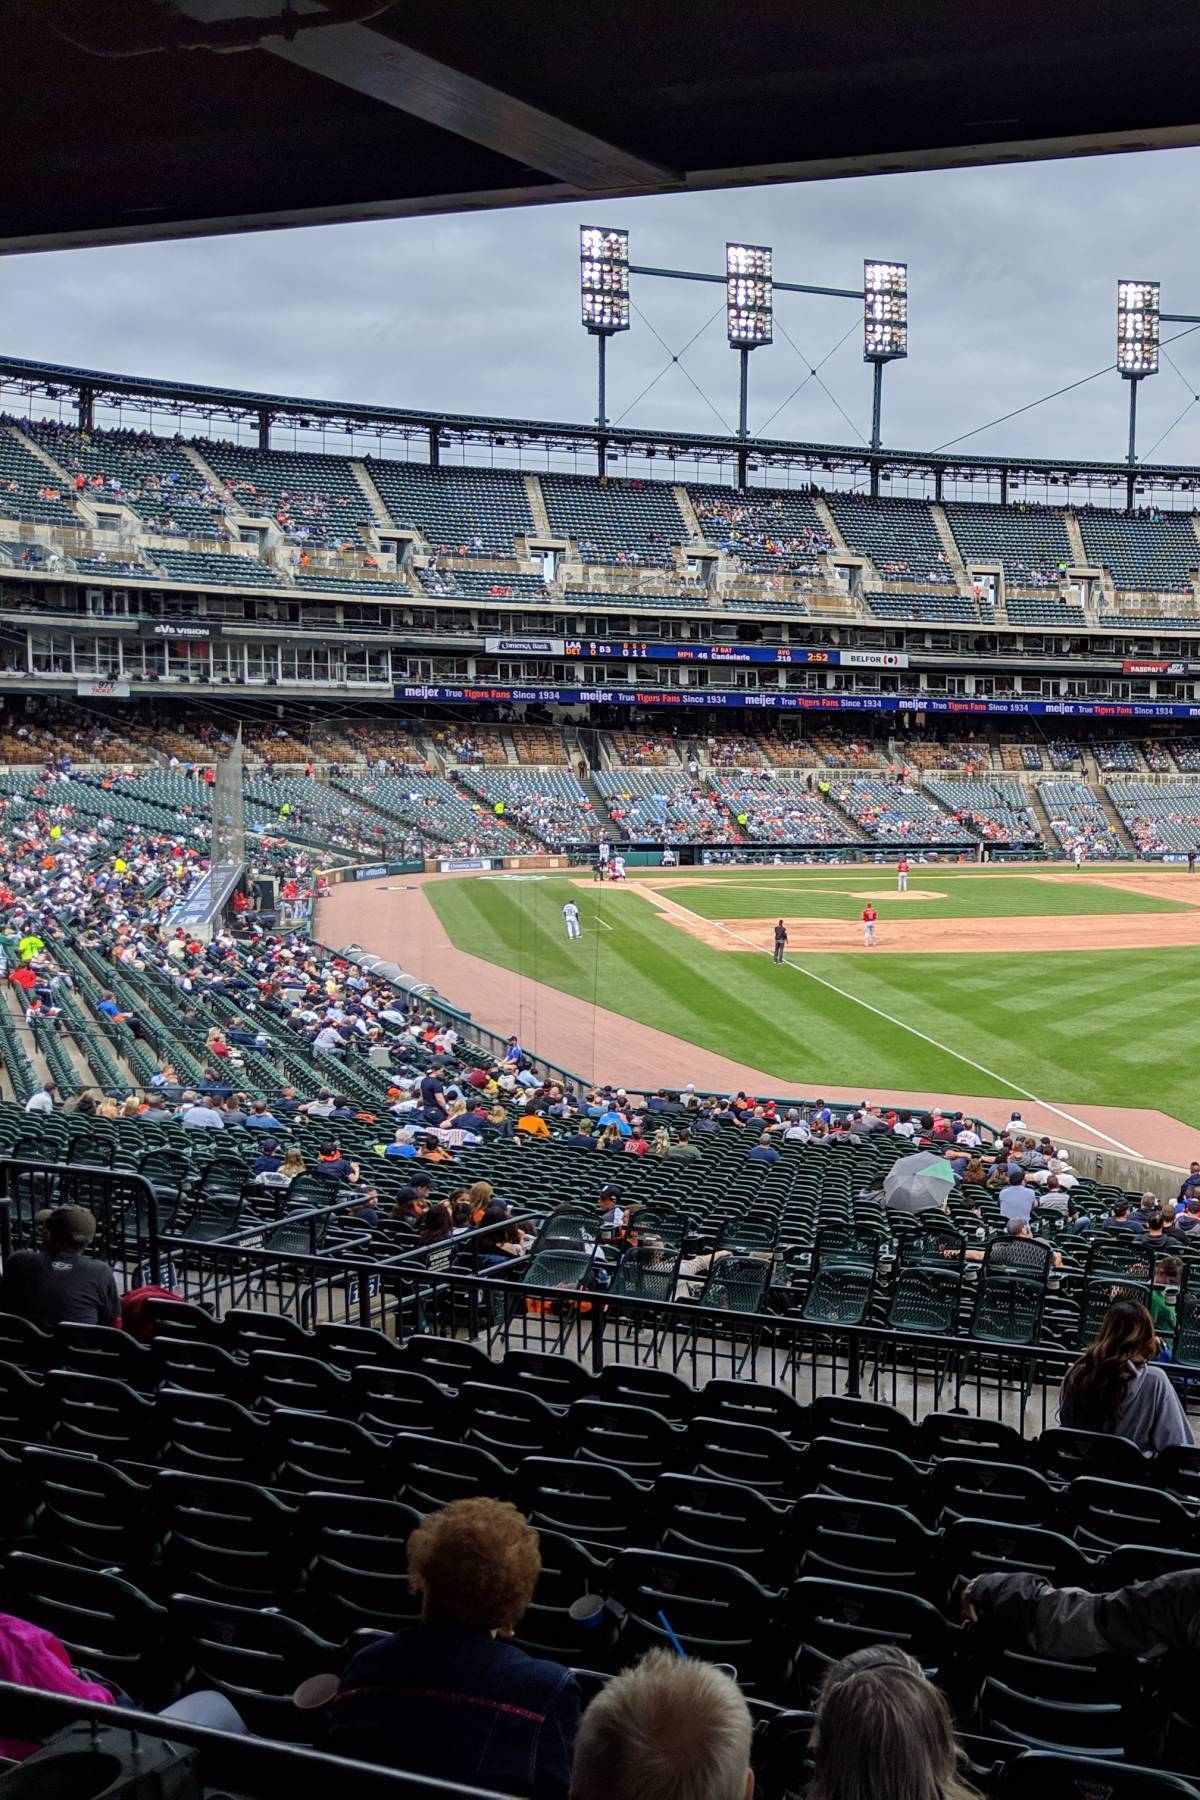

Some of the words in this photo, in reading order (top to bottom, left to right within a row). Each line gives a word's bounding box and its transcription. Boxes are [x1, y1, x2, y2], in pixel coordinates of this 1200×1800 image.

[565, 641, 582, 649] LAA
[711, 653, 750, 661] Candelario
[807, 653, 829, 662] 2:52
[850, 655, 881, 663] BELFOR
[405, 686, 439, 699] meijer
[445, 689, 462, 697] True
[464, 689, 489, 699] Tigers
[491, 689, 511, 699] Fans
[513, 690, 535, 699] Since
[538, 691, 560, 699] 1934
[580, 690, 612, 703] meijer
[618, 693, 635, 701] True
[636, 693, 660, 704] Tigers
[662, 694, 680, 703] Fans
[682, 695, 704, 703] Since
[706, 695, 727, 704] 1934
[745, 695, 776, 707] meijer
[781, 698, 796, 706] True
[797, 698, 820, 708] Tigers
[821, 698, 838, 707] Fans
[840, 699, 861, 707] Since
[863, 700, 881, 708] 1934
[899, 699, 927, 711] meijer
[948, 702, 969, 712] Tigers
[970, 703, 987, 711] Fans
[988, 703, 1008, 711] Since
[1010, 704, 1028, 712] 1934
[1045, 703, 1074, 715] meijer
[1094, 706, 1115, 716] Tigers
[1116, 707, 1132, 715] Fans
[1134, 707, 1153, 715] Since
[1155, 707, 1173, 715] 1934
